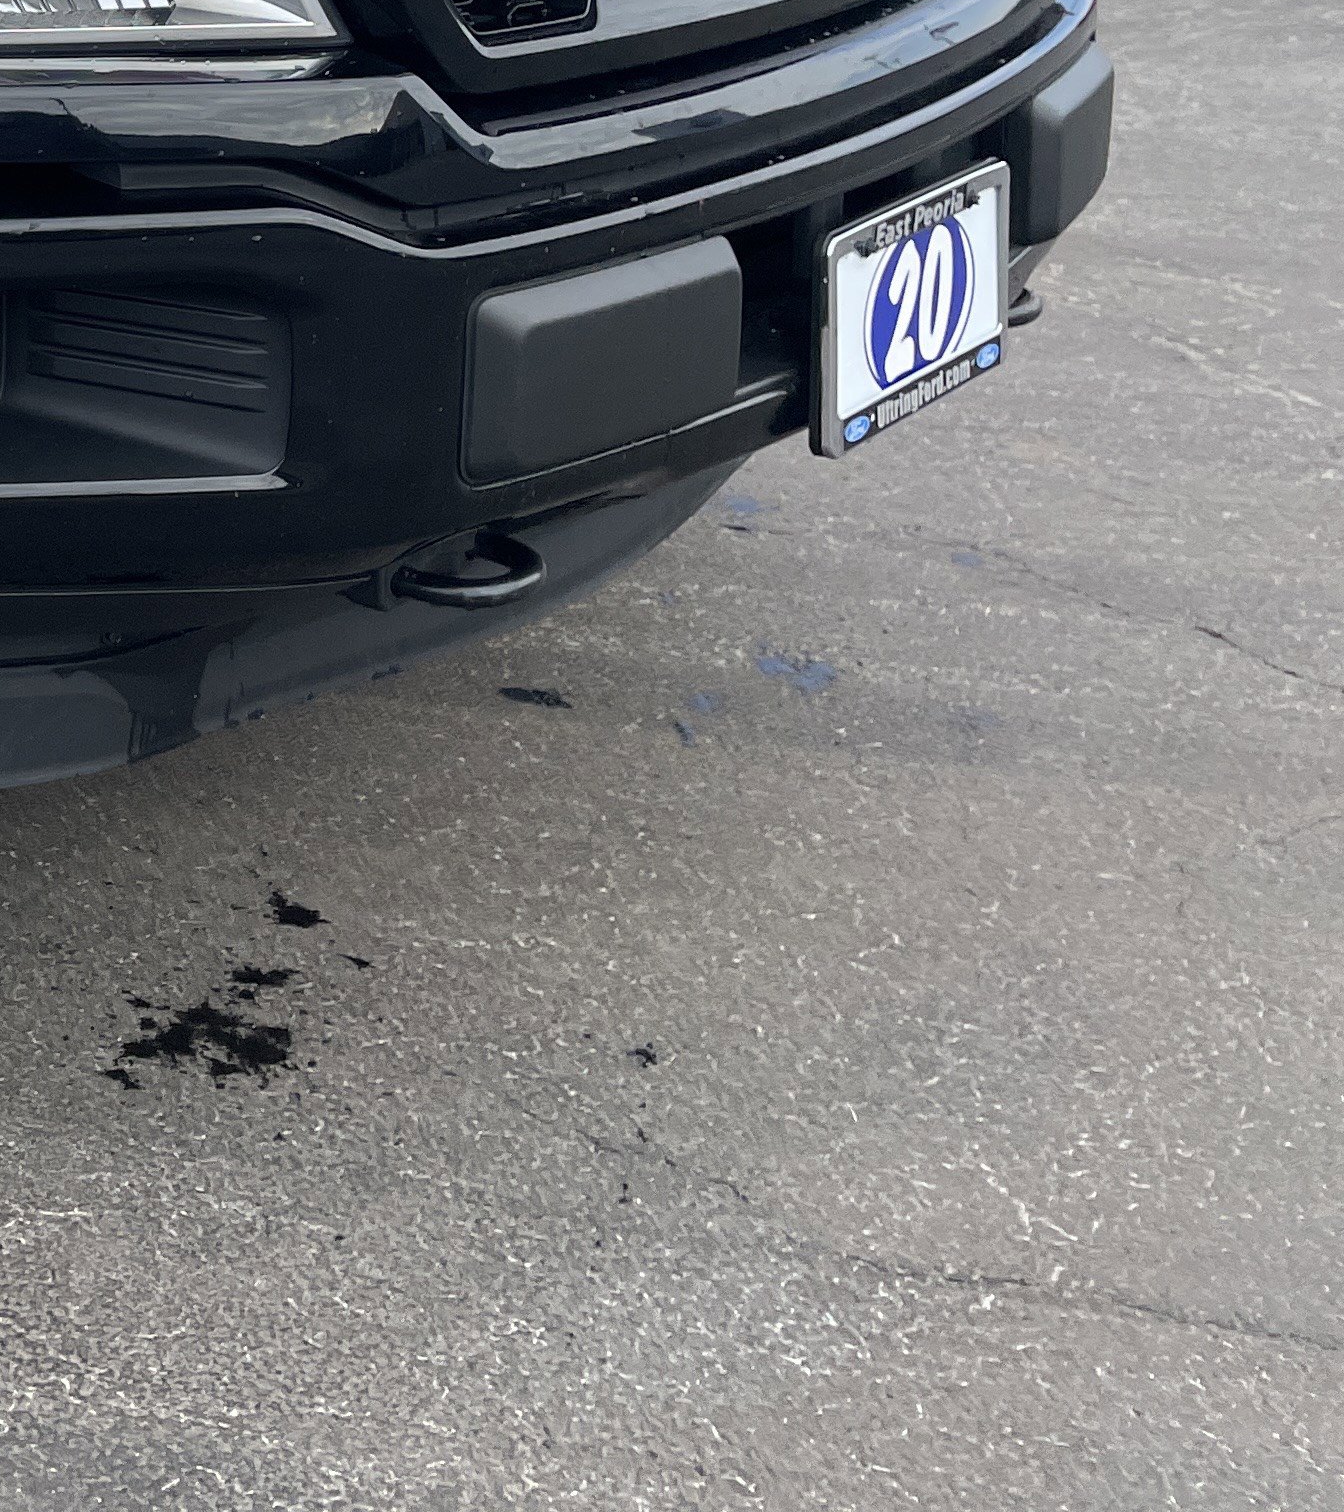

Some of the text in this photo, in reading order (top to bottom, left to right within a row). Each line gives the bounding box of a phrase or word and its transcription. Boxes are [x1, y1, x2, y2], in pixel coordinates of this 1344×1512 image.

[874, 188, 965, 248] East Peoria
[883, 223, 954, 383] 20
